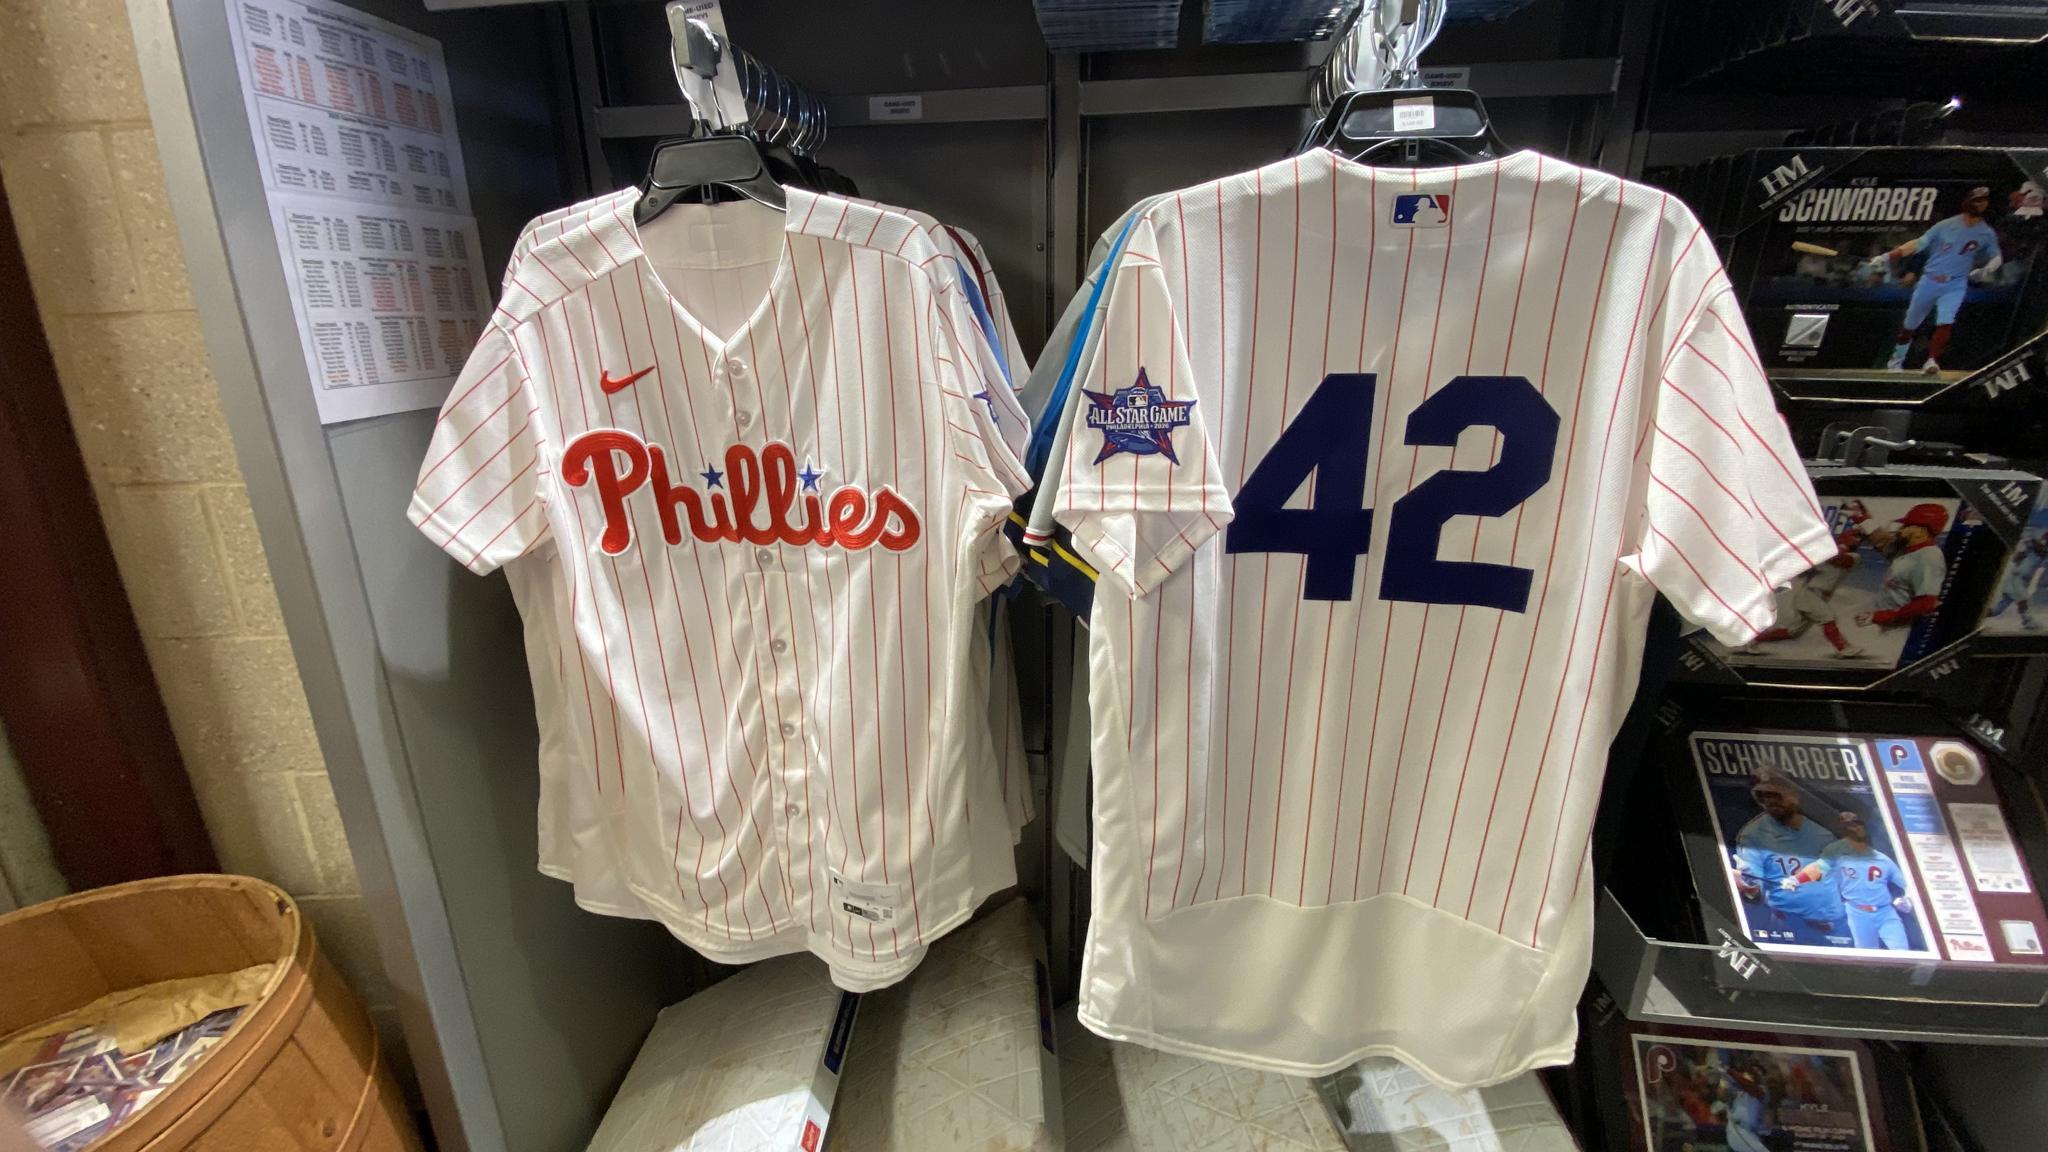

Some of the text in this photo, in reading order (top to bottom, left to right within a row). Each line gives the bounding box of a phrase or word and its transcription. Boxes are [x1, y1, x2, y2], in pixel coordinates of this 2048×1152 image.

[1758, 154, 1811, 197] HM
[1851, 177, 1879, 186] KYLE
[1779, 187, 1938, 222] SCHWARBER
[1089, 405, 1187, 425] ALL STAR GAME
[1106, 423, 1149, 431] PHILADELPHIA
[561, 428, 922, 555] Phillies
[1225, 373, 1562, 614] 42
[1702, 741, 1864, 782] SCHWARBER
[1776, 857, 1802, 876] 12
